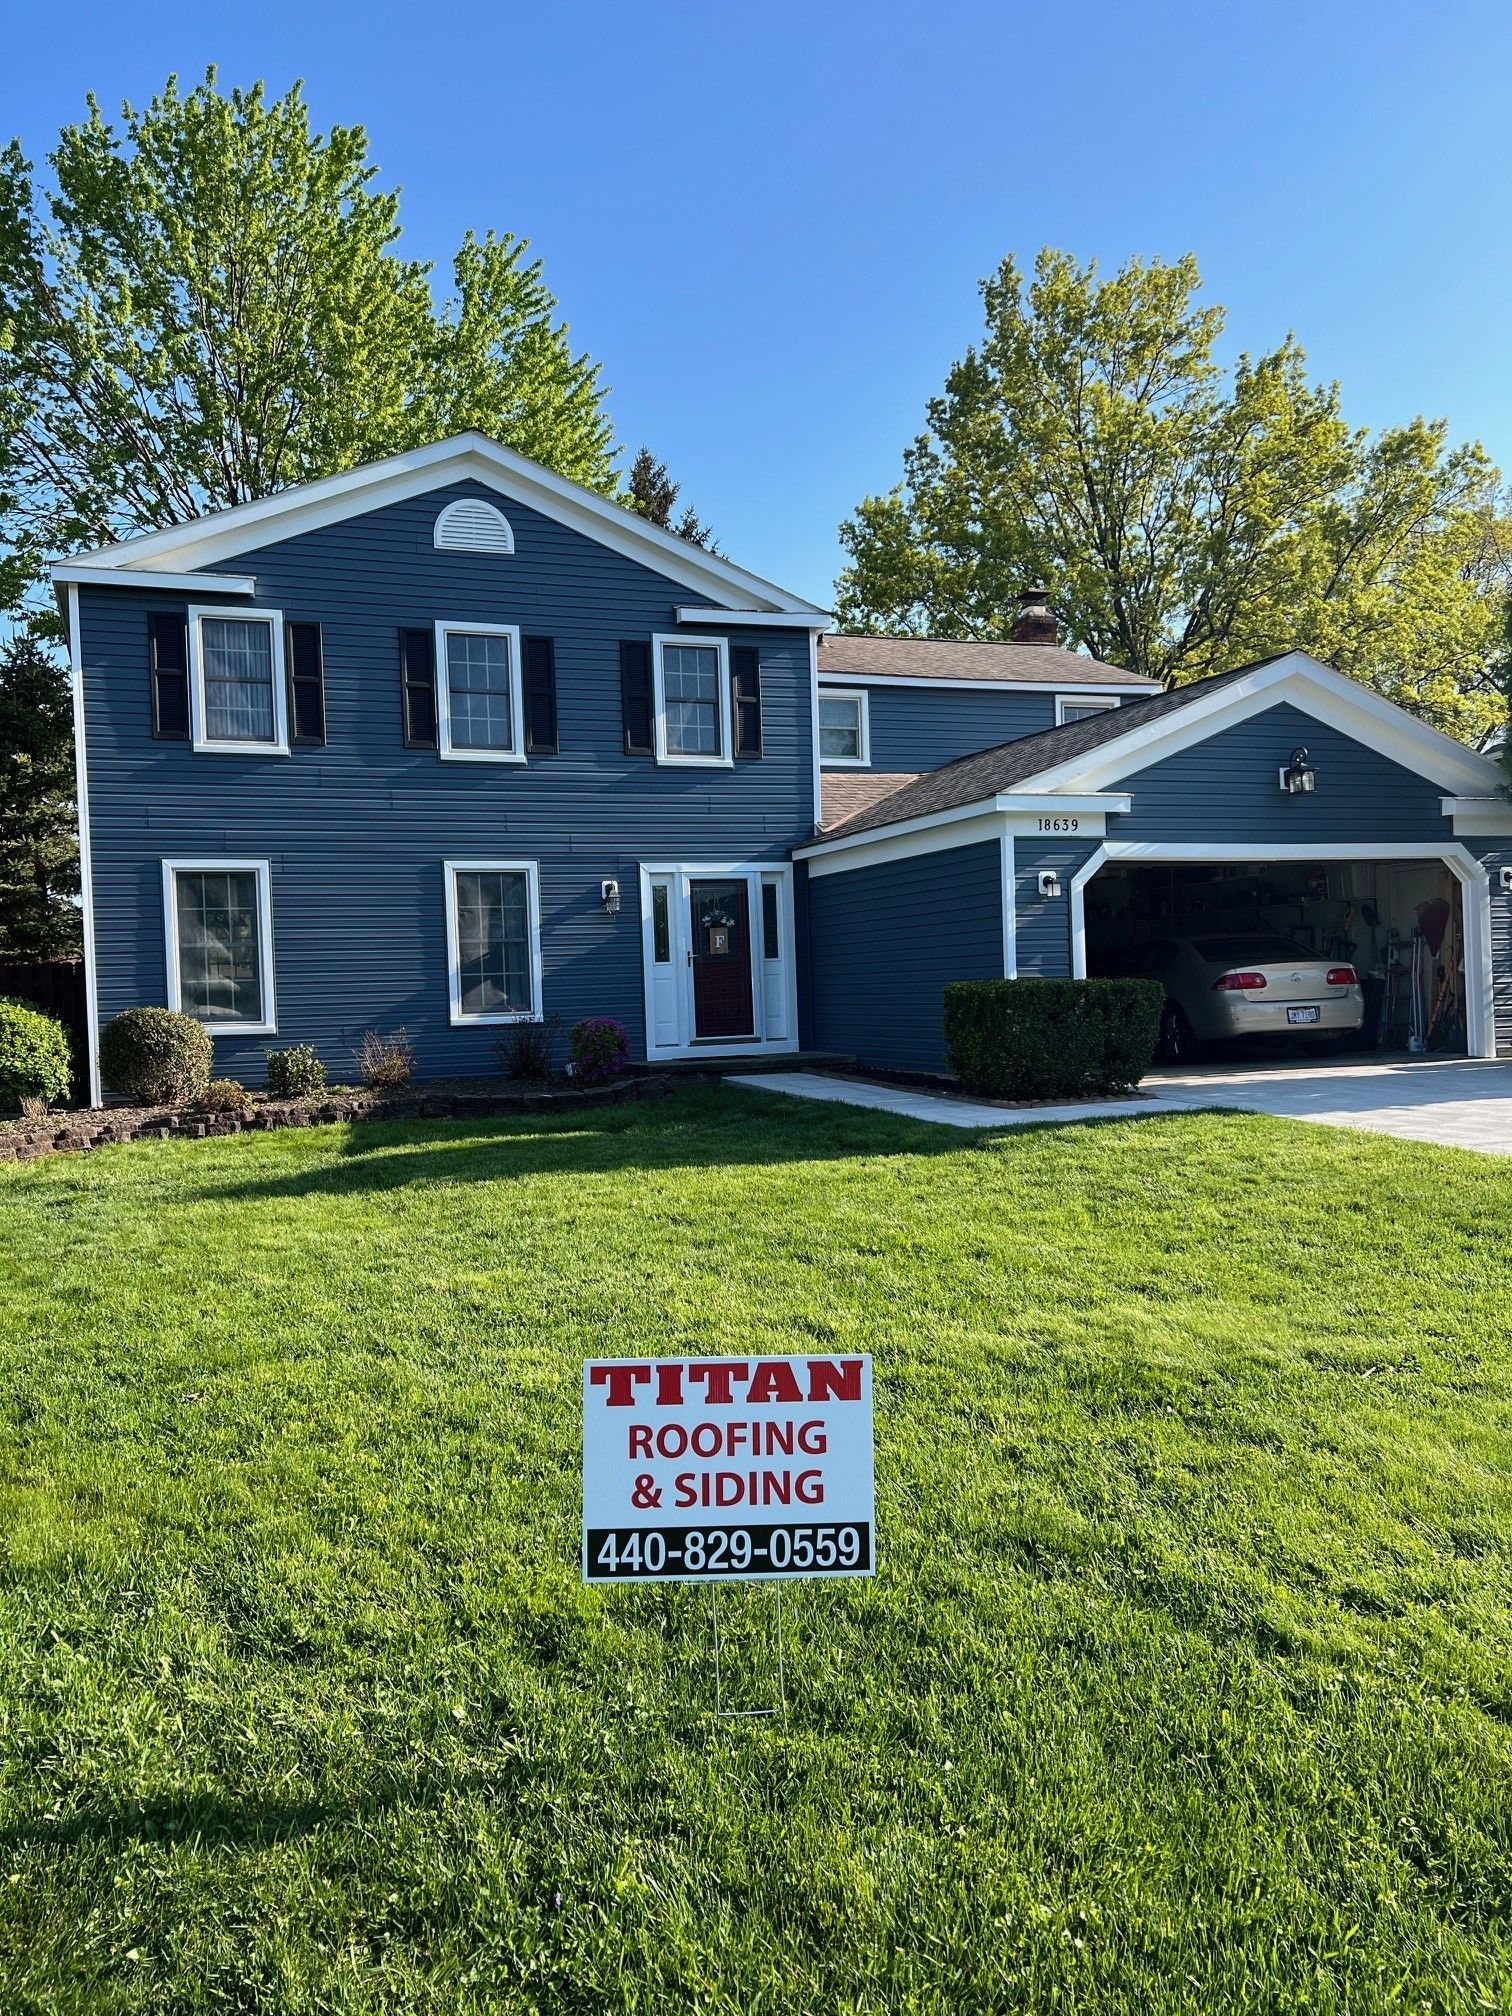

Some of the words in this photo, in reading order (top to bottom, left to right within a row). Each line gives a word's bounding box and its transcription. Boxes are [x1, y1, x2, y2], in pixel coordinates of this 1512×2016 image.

[1037, 818, 1079, 832] 18639
[715, 935, 725, 948] F
[590, 1360, 863, 1406] TITAN
[628, 1420, 827, 1459] ROOFING
[630, 1474, 663, 1508] &
[674, 1469, 824, 1508] SIDING
[597, 1526, 861, 1572] 440-829-0559
